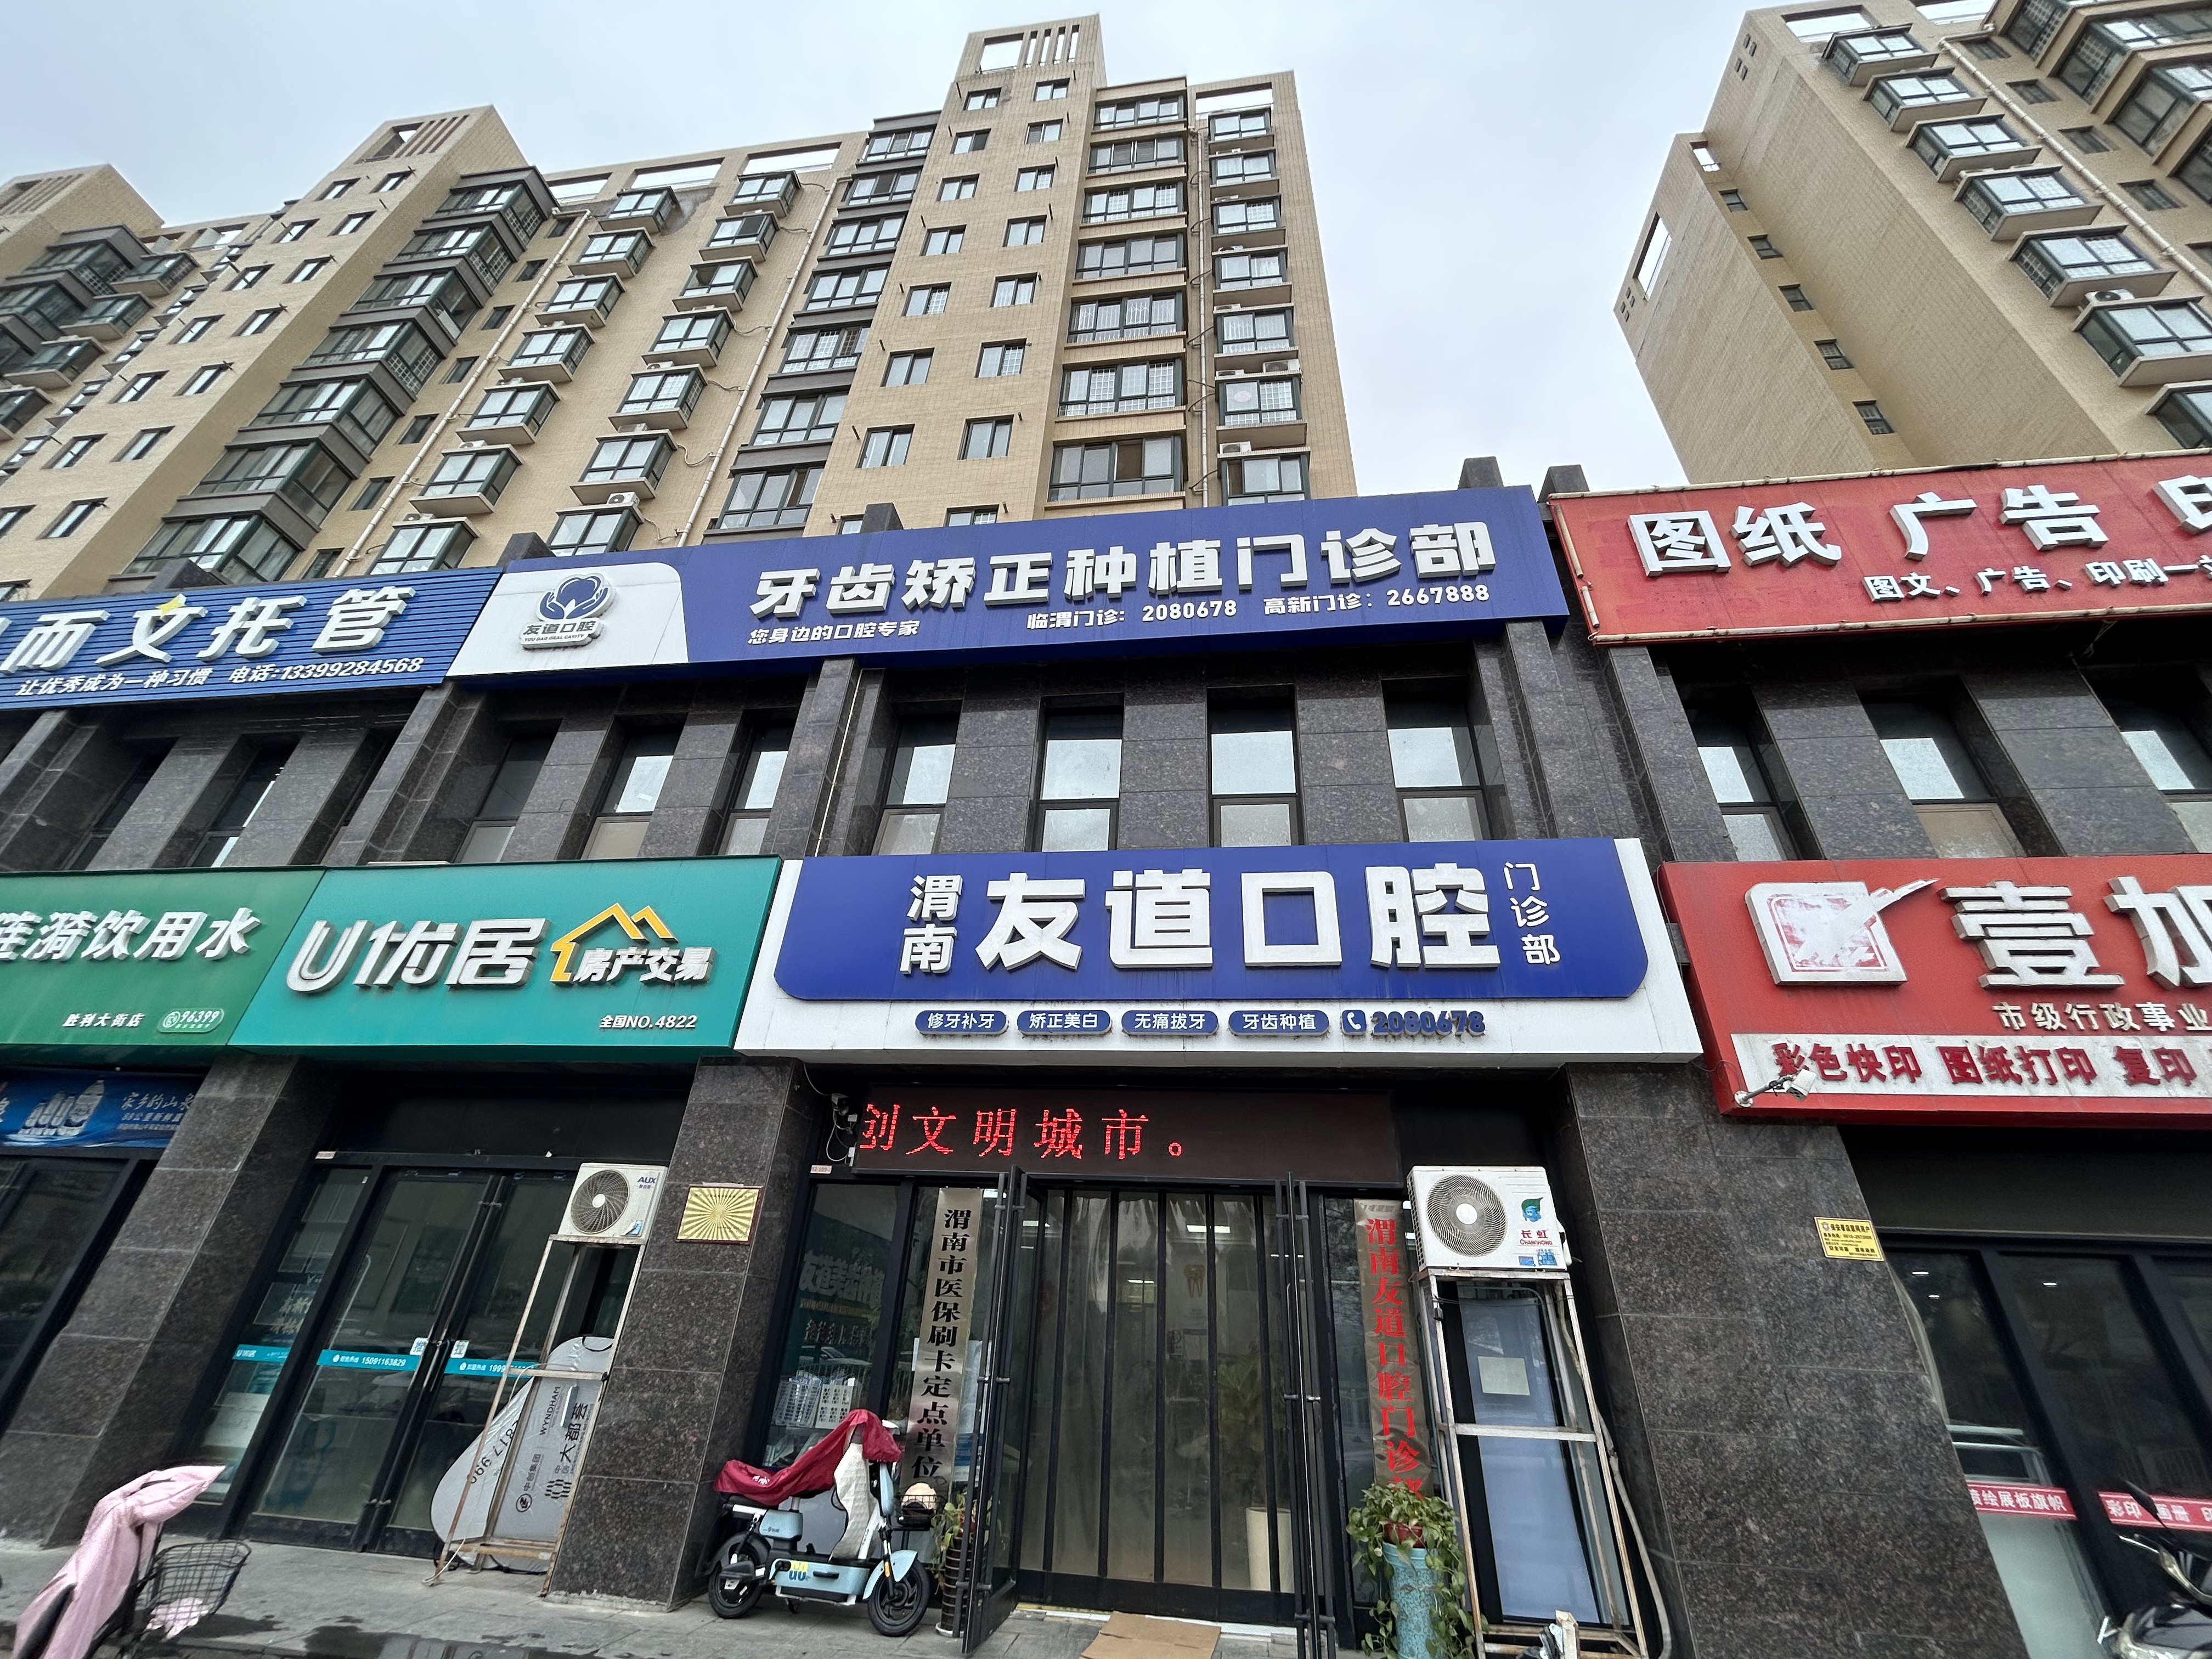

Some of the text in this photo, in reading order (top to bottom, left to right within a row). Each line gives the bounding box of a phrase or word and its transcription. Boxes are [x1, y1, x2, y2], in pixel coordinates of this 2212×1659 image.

[1627, 501, 1842, 577] 图纸
[1889, 484, 2109, 561] 广告
[749, 521, 1497, 619] 牙齿矫正种植门诊部
[1386, 584, 1490, 607] 2667888
[1141, 600, 1238, 622] 2080678
[0, 585, 417, 675] 而文托管
[523, 620, 596, 635] 友道口腔
[748, 620, 921, 645] 您身边的口腔专家
[15, 667, 213, 696] 让优秀成为一种习惯
[899, 874, 963, 975] 渭南
[975, 862, 1500, 971] 友道口腔
[1503, 861, 1561, 966] 门诊部
[573, 946, 718, 985] 房产交易
[61, 1013, 145, 1028] 胜利大街店
[179, 1011, 221, 1023] 96399
[599, 1014, 698, 1029] 全国NO.4822
[927, 1012, 996, 1030] 修牙补牙
[1028, 1012, 1099, 1030] 矫正美白
[1133, 1012, 1206, 1030] 无痛拔牙
[1241, 1012, 1317, 1031] 牙齿种植
[1371, 1010, 1486, 1037] 2080678
[1991, 1001, 2212, 1032] 市级行政事业
[1771, 1042, 2197, 1086] 彩色快印 图纸打印 复印
[1521, 1229, 1548, 1239] 长虹
[910, 1207, 972, 1480] 渭南市医保刷卡定点单位
[540, 1386, 561, 1436] WYNDHAM
